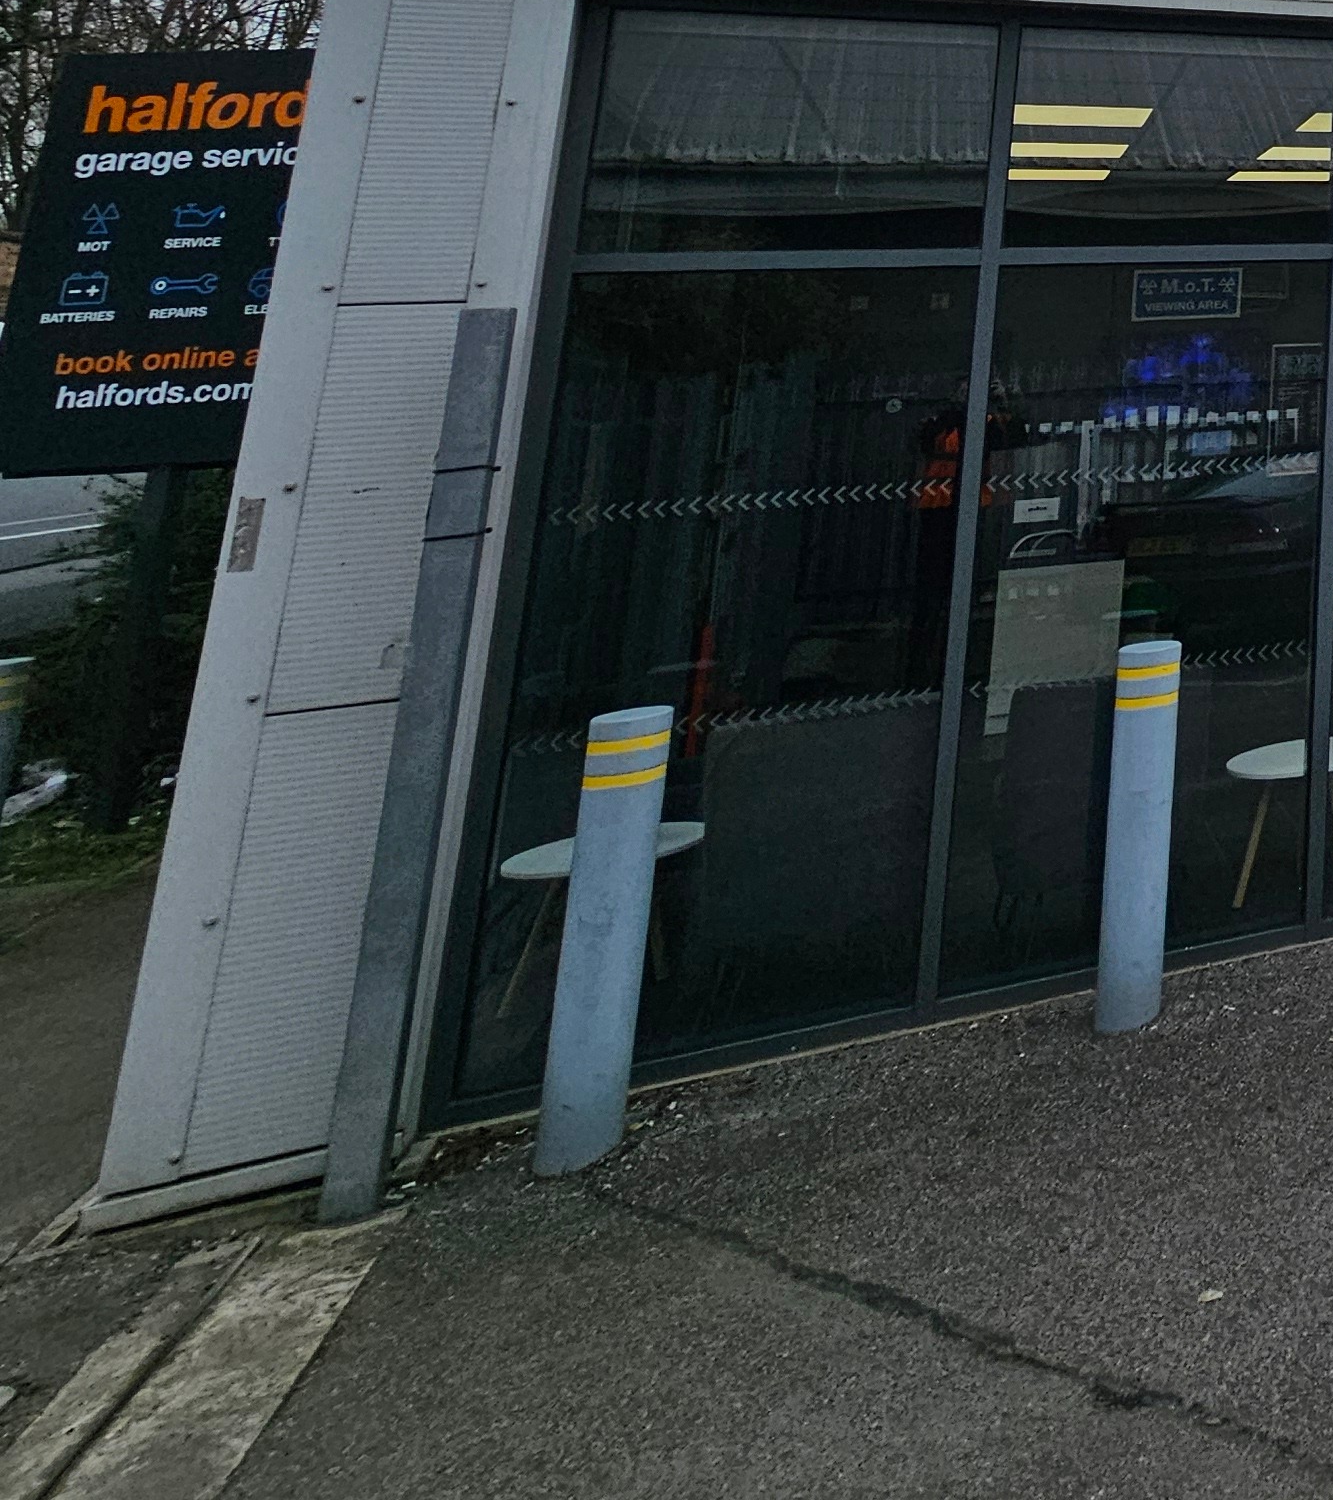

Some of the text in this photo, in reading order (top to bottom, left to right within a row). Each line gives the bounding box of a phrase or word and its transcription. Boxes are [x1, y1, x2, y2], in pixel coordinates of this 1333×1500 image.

[75, 148, 192, 178] garage
[78, 241, 111, 252] MOT
[164, 236, 222, 249] SERVICE
[1144, 299, 1229, 312] VIEWING AREA
[40, 309, 115, 324] BATTERIES
[149, 306, 207, 319] REPAIRS
[54, 349, 132, 375] book
[142, 346, 236, 371] online
